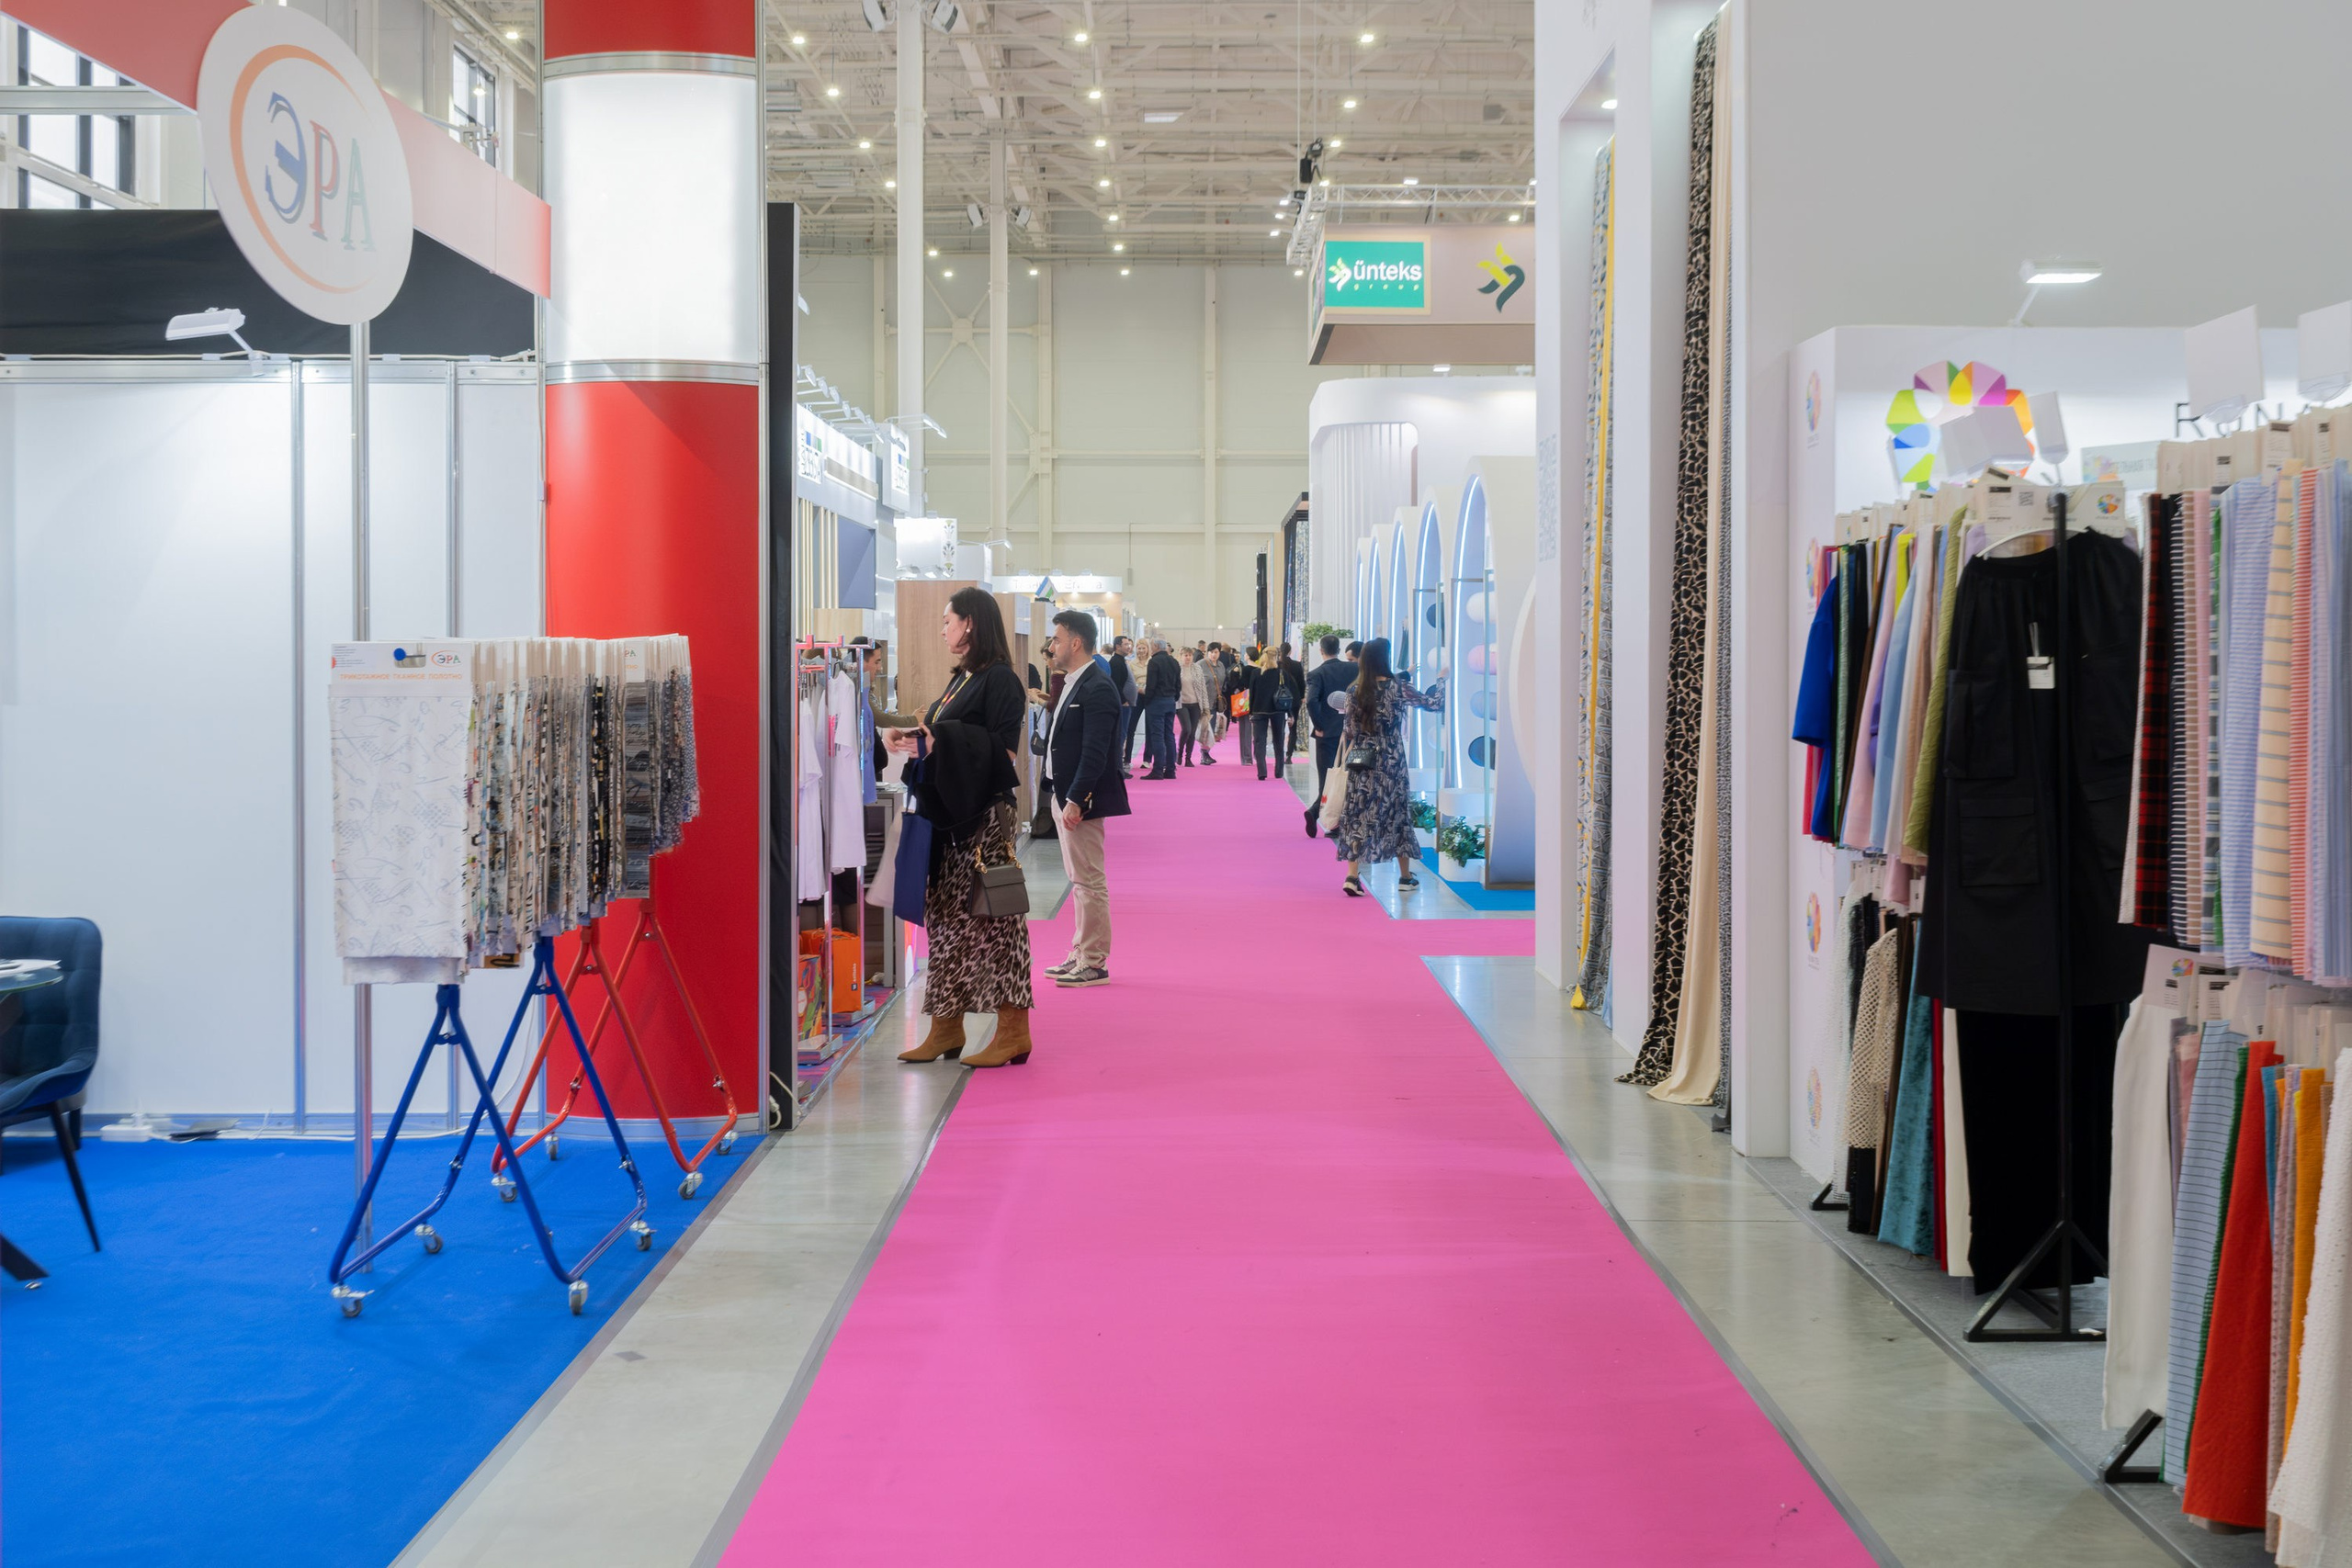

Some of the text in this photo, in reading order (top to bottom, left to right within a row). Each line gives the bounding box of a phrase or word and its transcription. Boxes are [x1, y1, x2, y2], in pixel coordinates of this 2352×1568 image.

[265, 91, 377, 252] ЭРА
[1353, 259, 1422, 281] ünteks
[436, 654, 461, 664] ЭРА
